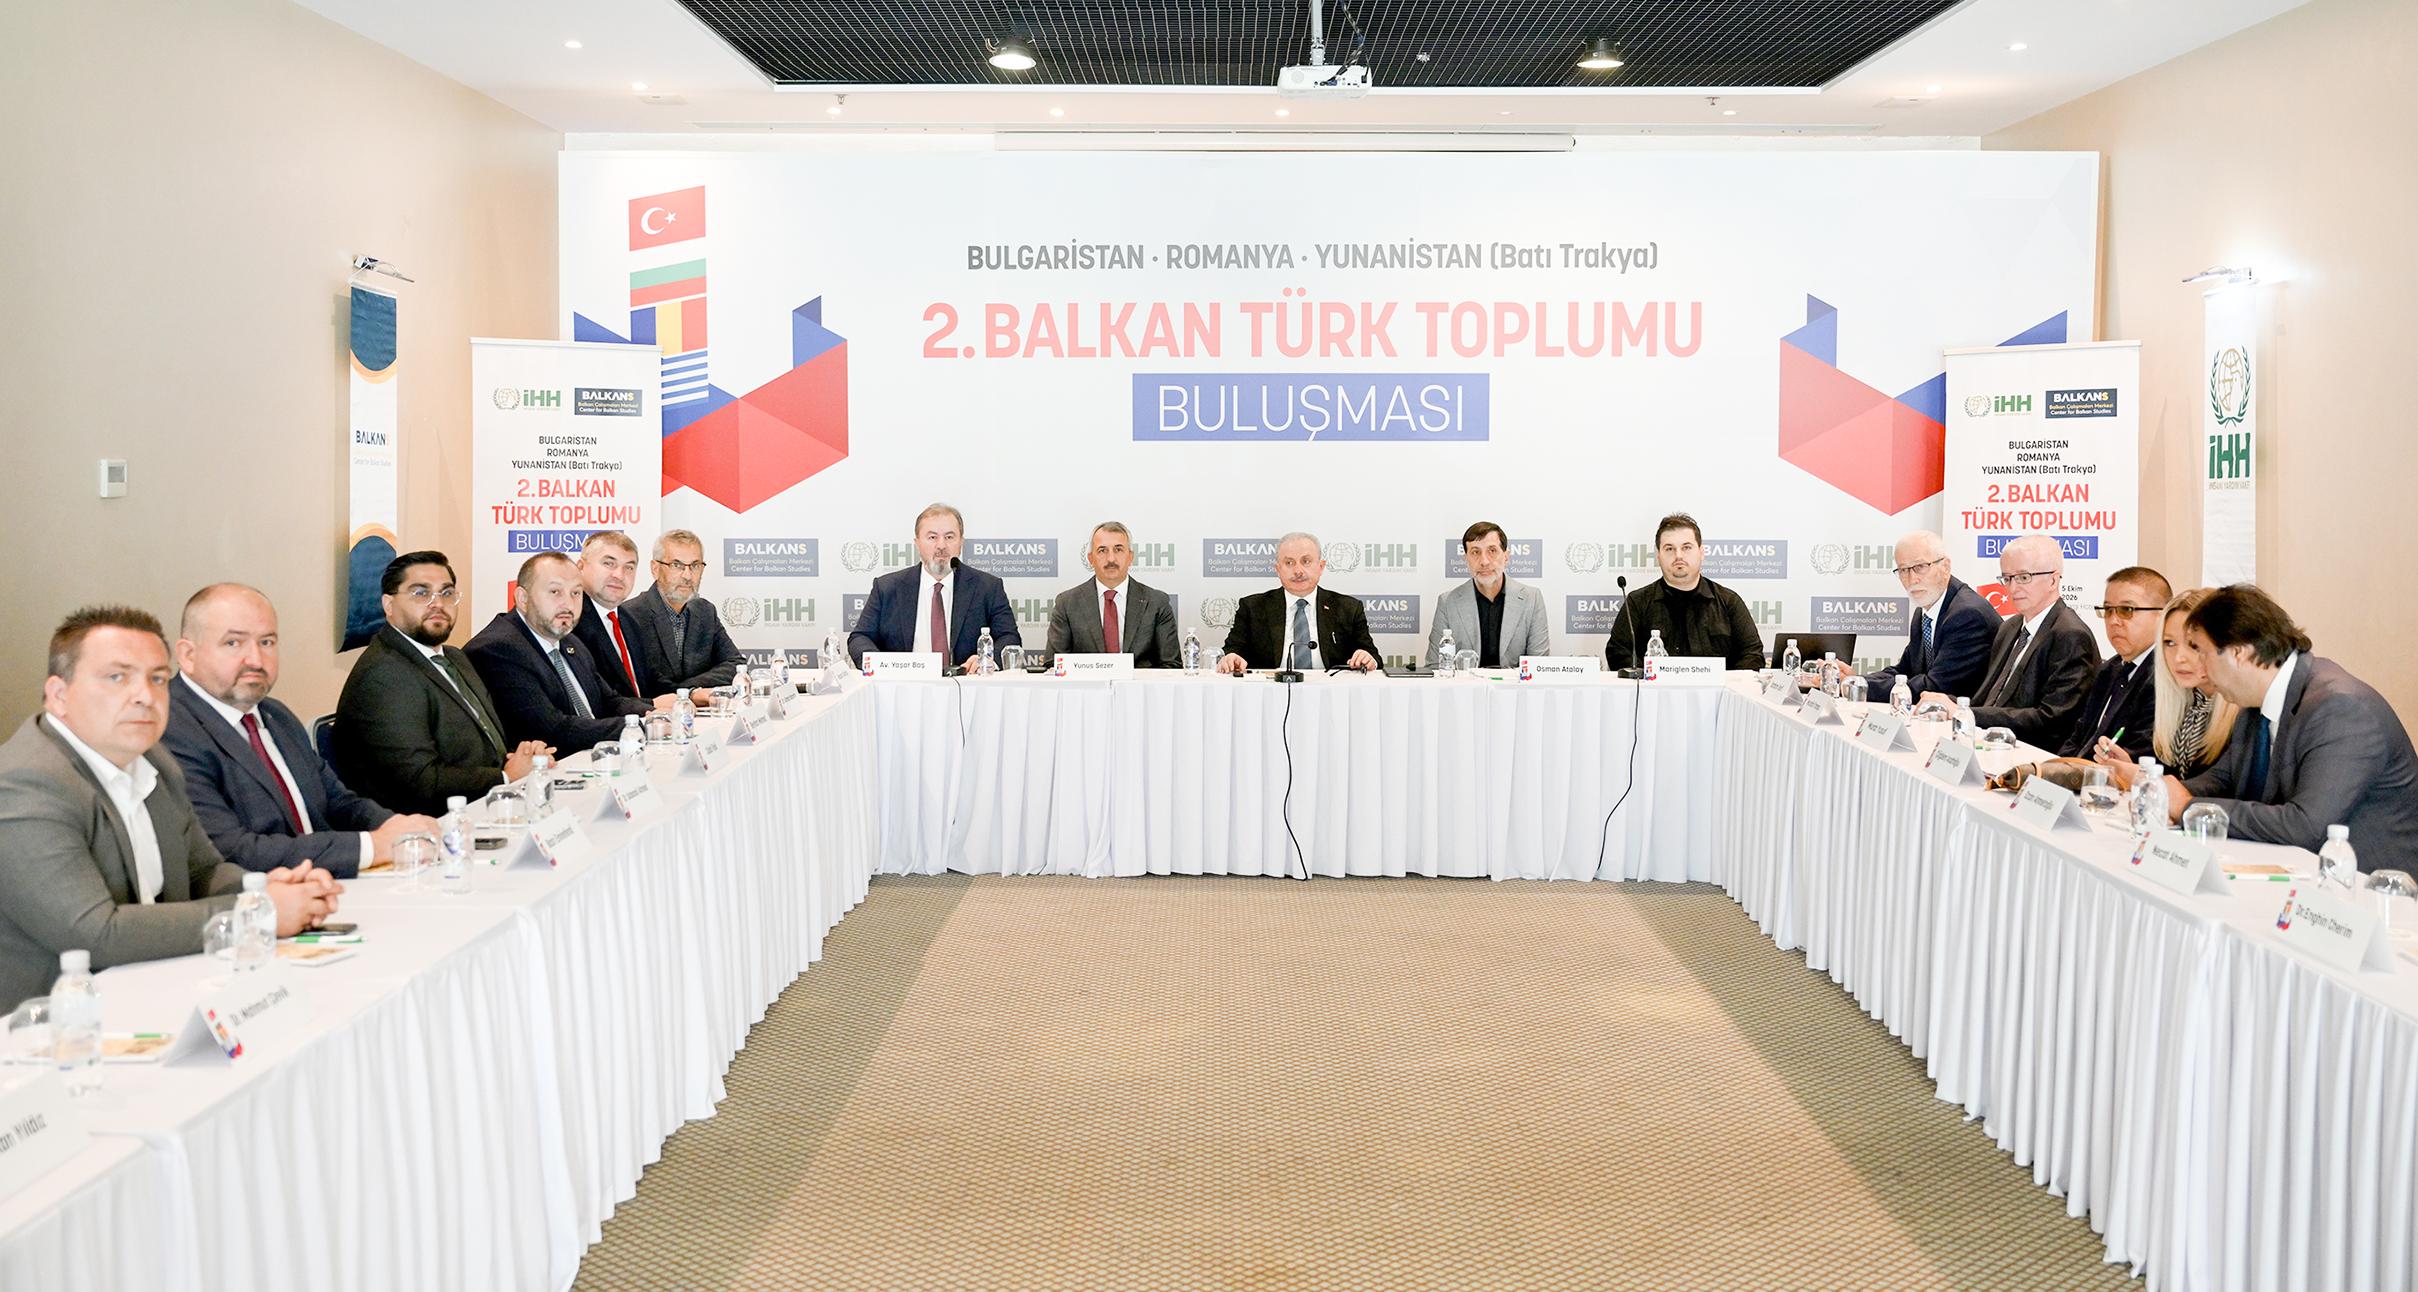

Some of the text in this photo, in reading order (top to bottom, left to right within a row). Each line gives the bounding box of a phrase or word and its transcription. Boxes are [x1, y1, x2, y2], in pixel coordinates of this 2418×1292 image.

[967, 237, 1658, 275] BULGARİSTAN ROMANYA YUNANİSTAN (Batı Trakya)
[1239, 286, 1399, 359] TÜRK
[1415, 300, 1703, 358] TOPLUMU
[582, 391, 635, 401] BALKANS
[2053, 391, 2109, 403] BALKANS
[1158, 383, 1464, 442] BULUŞMASI
[356, 430, 387, 446] BALKAN
[538, 435, 597, 446] BULGARİSTAN
[2008, 438, 2069, 450] BULGARİSTAN
[546, 448, 589, 458] ROMANYA
[2016, 452, 2061, 462] ROMANYA
[511, 459, 567, 470] YUNANİSTAN
[1981, 464, 2037, 475] YUNANİSTAN
[491, 500, 641, 525] TÜRK TOPLUMU
[1961, 506, 2116, 531] TÜRK TOPLUMU
[516, 533, 589, 553] BULUŞM
[735, 543, 807, 555] BALKANS
[1214, 543, 1277, 555] BALKAN
[1985, 539, 2090, 557] BUASI
[974, 543, 1047, 556] BALKANS
[1703, 545, 1776, 557] BALKANS
[731, 565, 811, 573] Center for Balkan Studies
[1364, 599, 1408, 612] KANS
[1577, 600, 1620, 612] BALK
[1822, 601, 1898, 614] BALKANS
[1876, 624, 1901, 632] Studies
[1536, 665, 1584, 674] Osman Atalay
[1659, 665, 1711, 674] Mariglen Shehi
